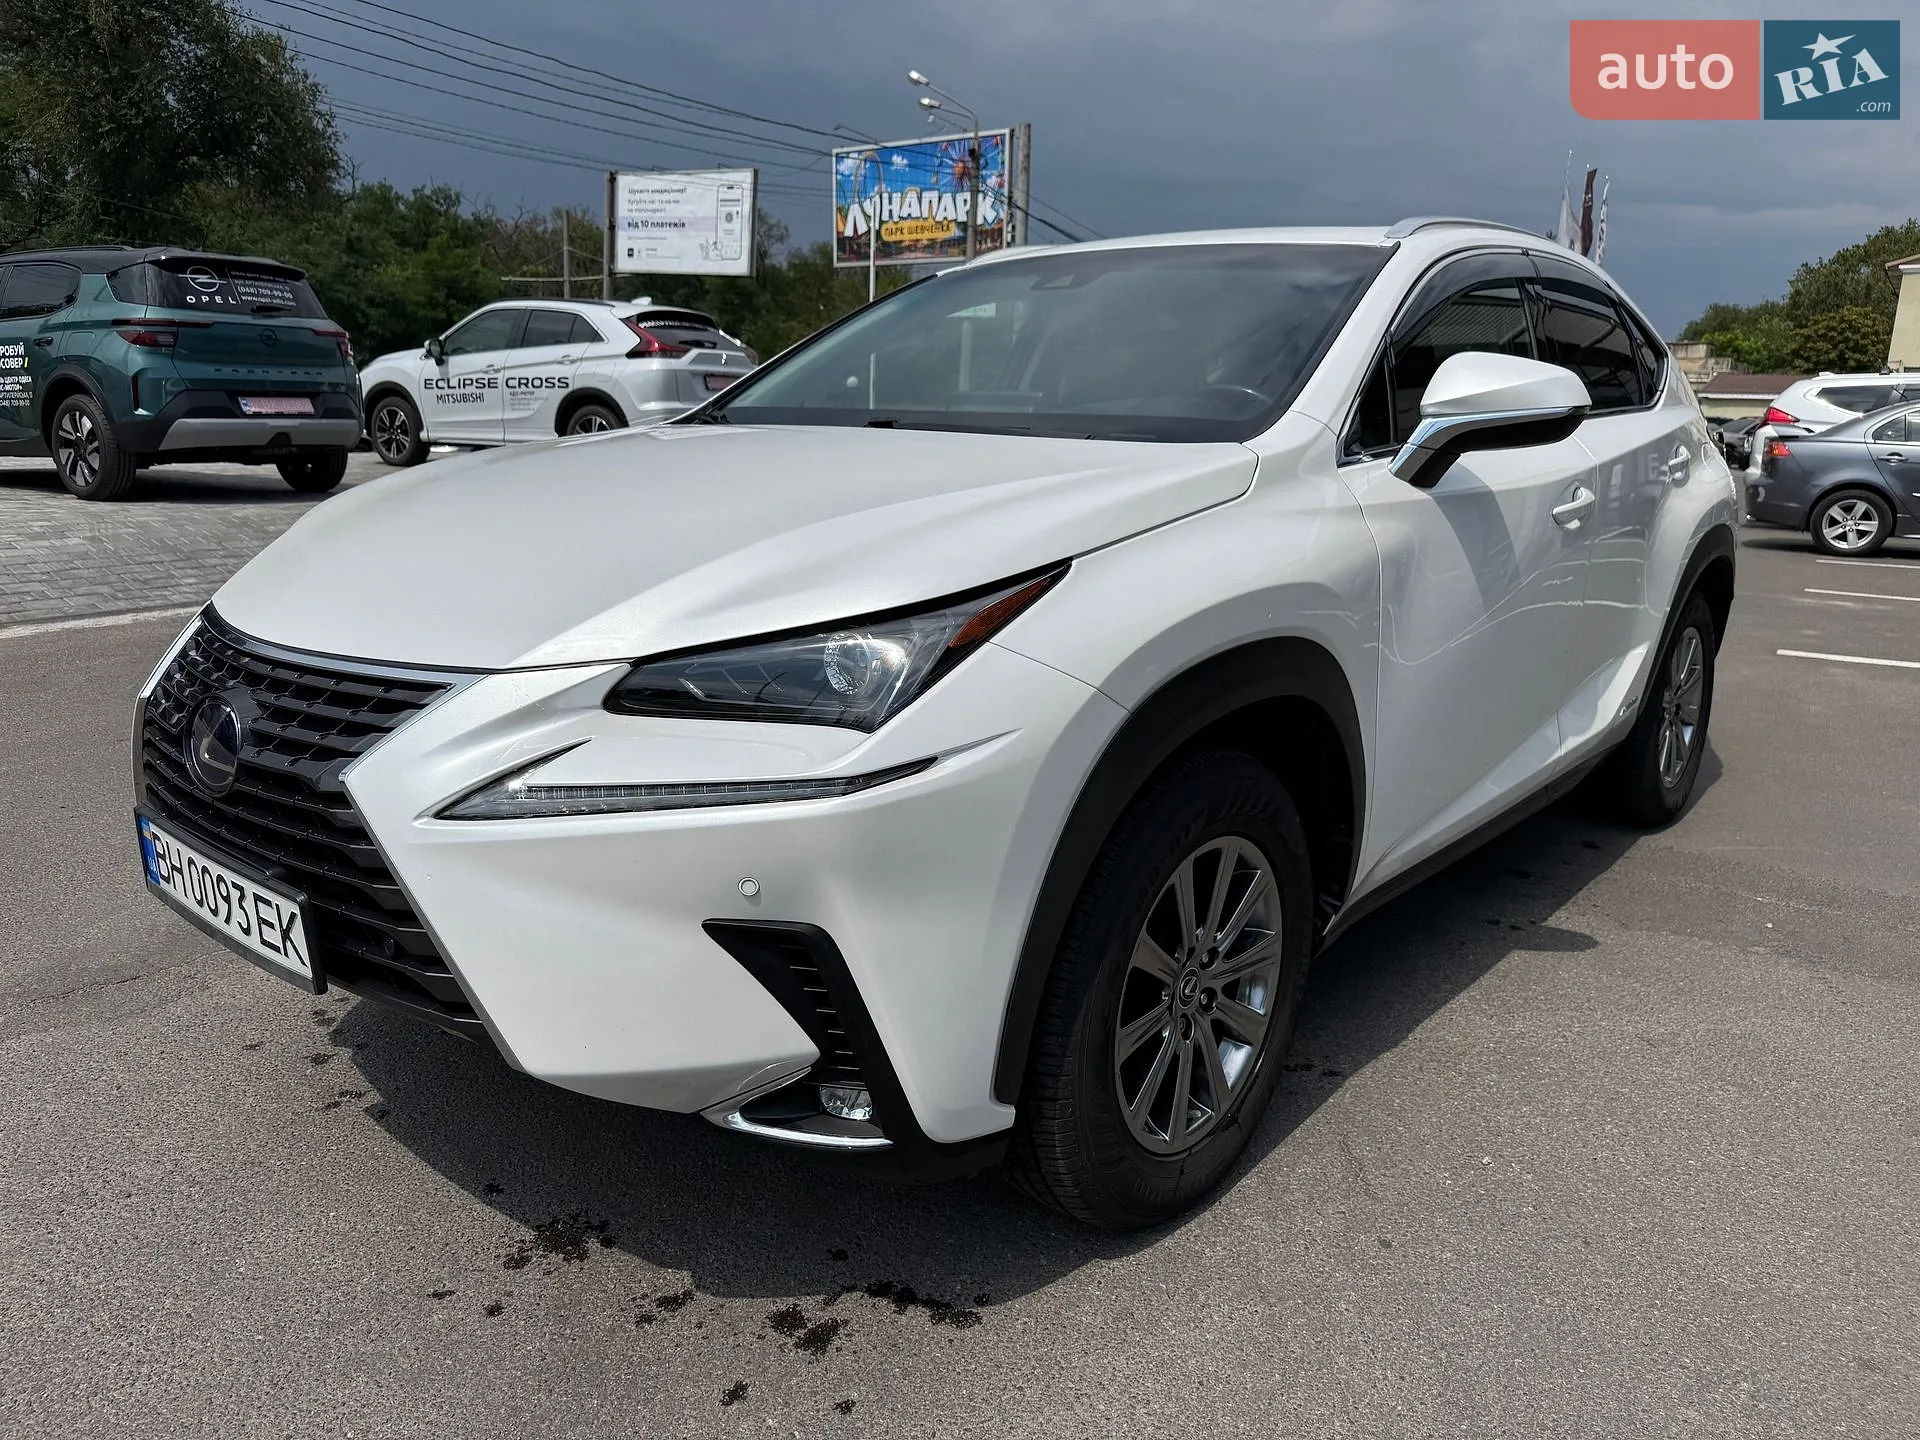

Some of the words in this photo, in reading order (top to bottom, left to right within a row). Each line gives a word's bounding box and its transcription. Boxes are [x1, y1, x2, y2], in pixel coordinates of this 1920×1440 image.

[628, 219, 639, 230] від
[641, 219, 650, 228] 10
[650, 219, 686, 228] платежів
[884, 225, 904, 237] ПАРК
[907, 222, 951, 236] ШЕВЧЕНКА
[186, 295, 237, 304] OPEL
[0, 357, 23, 369] СОВЕР
[424, 378, 499, 390] ECLIPSE
[505, 376, 570, 389] CROSS
[436, 392, 485, 404] MITSUBISHI
[188, 856, 252, 937] 0093
[252, 891, 308, 968] EK
